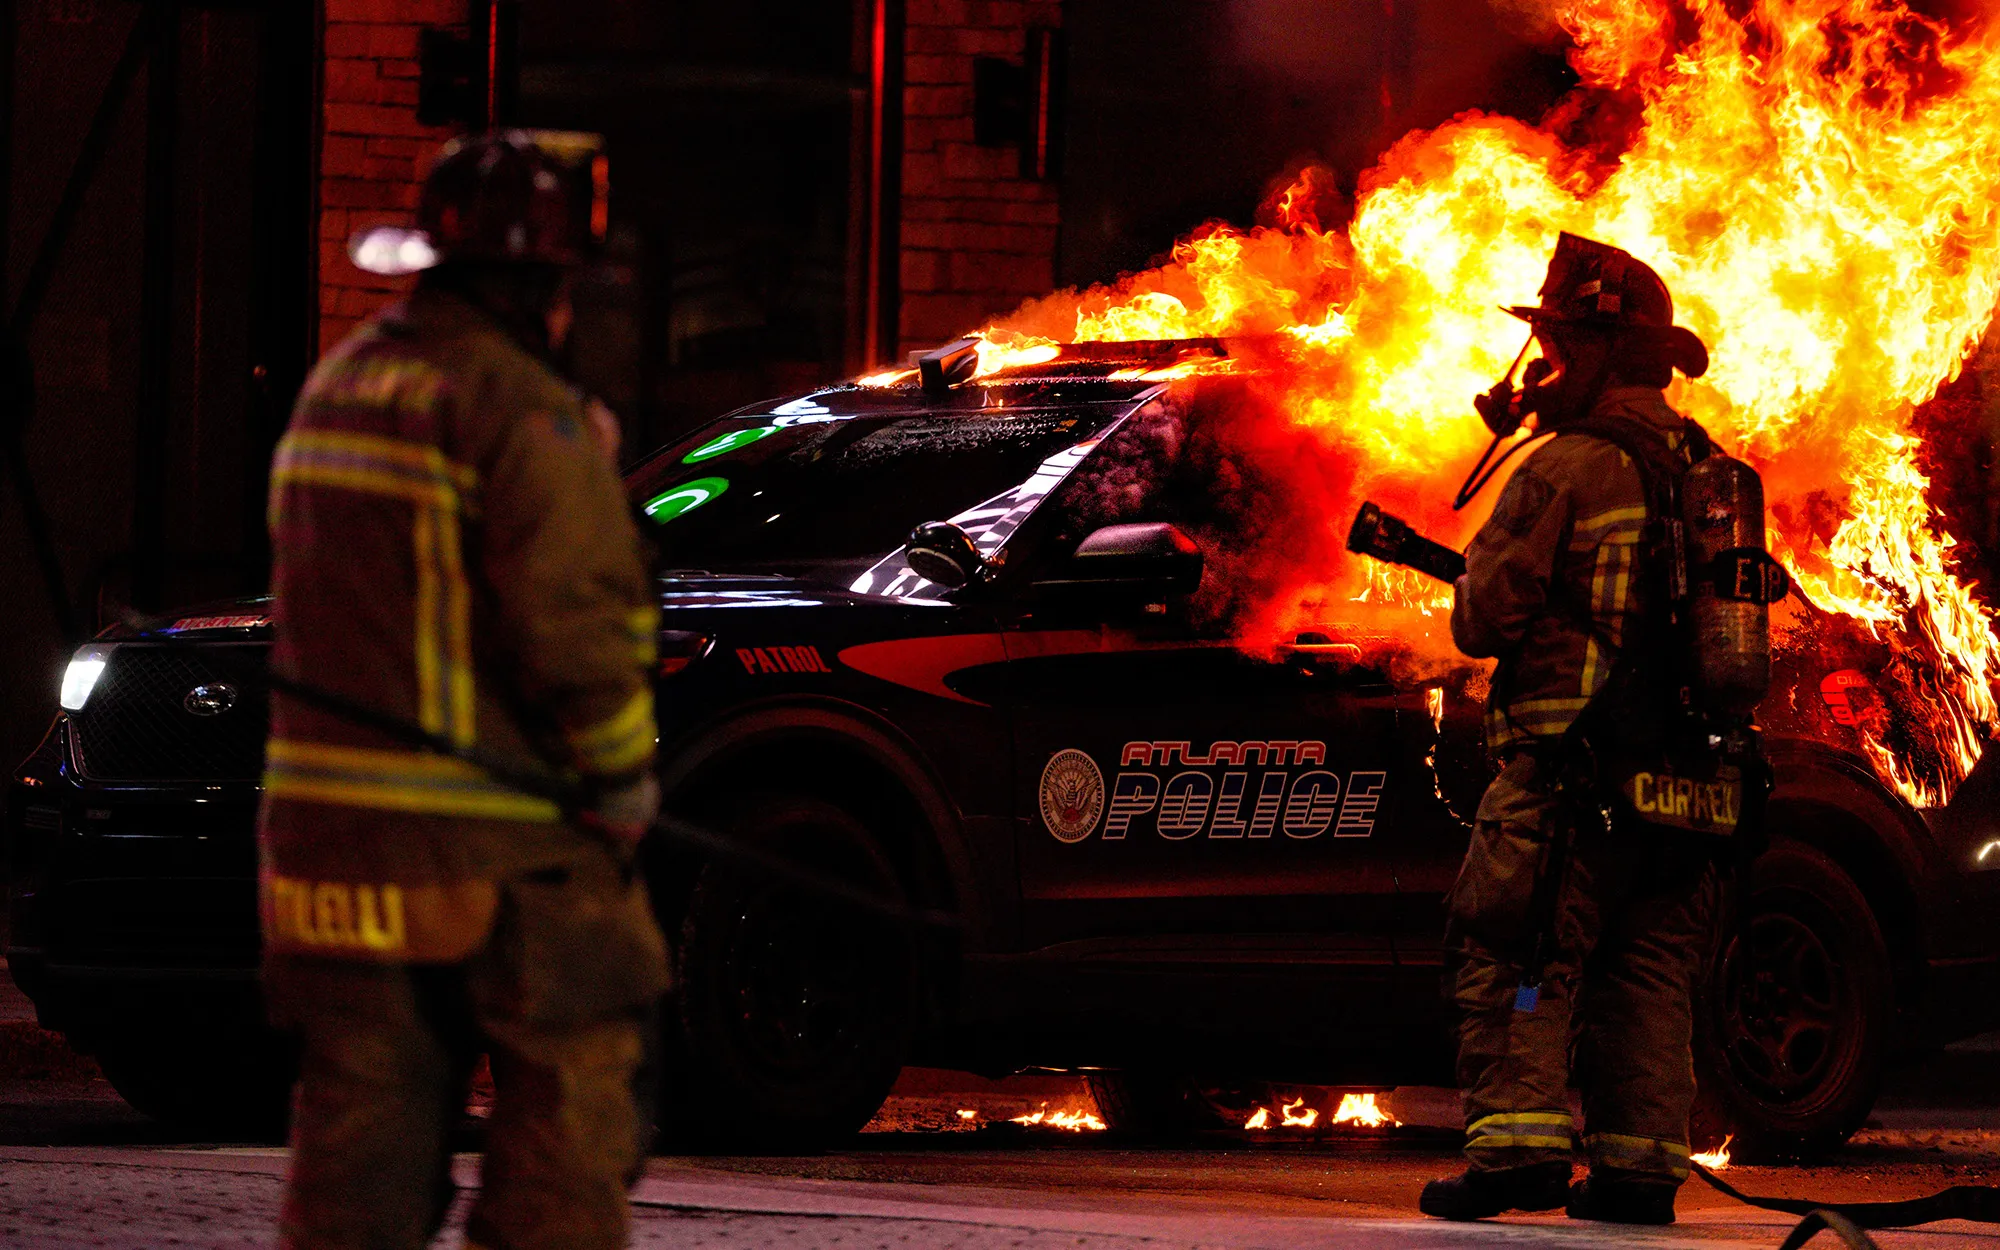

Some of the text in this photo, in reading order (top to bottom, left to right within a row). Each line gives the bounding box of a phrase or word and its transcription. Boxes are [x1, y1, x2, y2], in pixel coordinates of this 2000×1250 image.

[735, 645, 832, 674] PATROL
[1120, 741, 1326, 766] ATLANTA
[1102, 771, 1386, 840] POLICE
